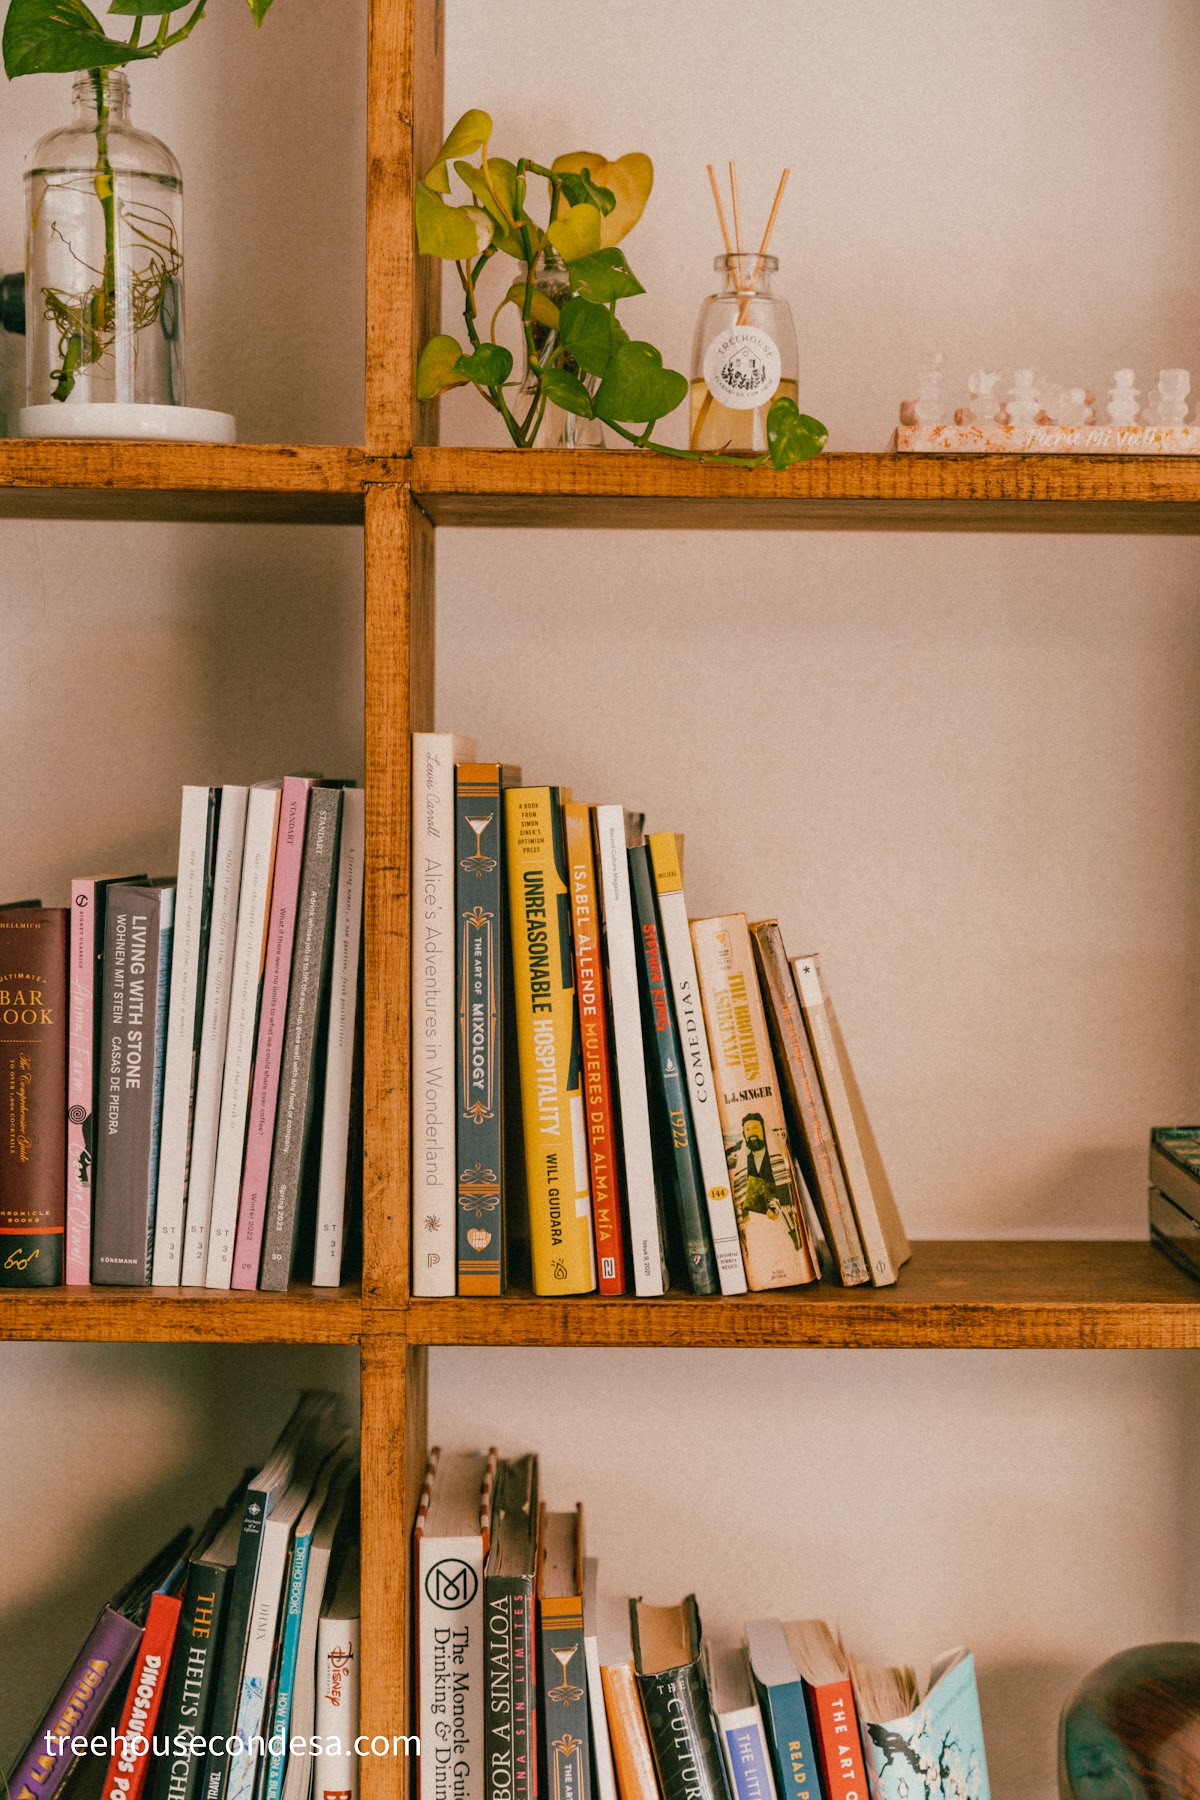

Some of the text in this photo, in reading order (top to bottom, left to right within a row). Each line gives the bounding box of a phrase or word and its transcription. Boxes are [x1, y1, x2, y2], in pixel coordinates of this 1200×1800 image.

[717, 334, 773, 357] TREEHOUSE
[426, 752, 440, 838] Lewis Carroll
[286, 800, 297, 845] STANDART
[315, 809, 326, 855] STANDART
[611, 872, 620, 901] Magazine
[278, 907, 286, 928] What
[308, 897, 317, 916] drink
[306, 917, 314, 942] whose
[572, 864, 596, 1015] ISABEL ALLENDE
[275, 935, 283, 955] there
[303, 941, 312, 954] job
[304, 954, 311, 962] is
[272, 975, 277, 985] no
[303, 962, 309, 971] to
[642, 924, 671, 1032] STEPHEN KING
[0, 990, 43, 1006] BAR
[125, 915, 146, 1088] LIVING WITH STONE
[270, 986, 278, 1007] limits
[300, 981, 308, 996] the
[0, 1008, 54, 1024] OOK
[269, 1007, 275, 1016] to
[298, 997, 306, 1013] soul
[472, 936, 484, 1089] THE ART OF MIXOLOGY
[522, 870, 560, 1136] UNREASONABLE HOSPITALITY
[72, 978, 93, 1091] Animal Farm
[108, 914, 126, 1135] WOHNEN MIT STEIN CASAS DE PIEDRA
[267, 1017, 275, 1035] what
[424, 857, 443, 1185] Alice's Adventures in Wonderland
[714, 987, 741, 1068] ASHKENAZI
[727, 971, 761, 1081] THE BROTHERS
[266, 1036, 271, 1047] we
[293, 1026, 301, 1044] goes
[680, 981, 708, 1103] COMEDIAS
[9, 1059, 14, 1069] TO
[263, 1048, 272, 1069] could
[293, 1044, 301, 1060] well
[261, 1070, 270, 1090] share
[291, 1060, 299, 1078] with
[288, 1078, 296, 1092] any
[739, 1086, 772, 1101] SINGER
[16, 1052, 31, 1162] The Comprehensive Guide
[288, 1092, 296, 1109] food
[256, 1108, 266, 1135] coffee?
[287, 1110, 292, 1119] or
[282, 1119, 291, 1154] company.
[584, 1022, 614, 1241] MUJERES DEL ALMA MÍA
[669, 1108, 689, 1149] 1922
[68, 1141, 91, 1268] George Orwell
[277, 1184, 286, 1209] Spring
[545, 1153, 562, 1246] WILL GUIDARA
[711, 1189, 725, 1198] 144
[246, 1192, 257, 1241] Winter 2022
[472, 1231, 486, 1239] LOVE
[288, 1546, 305, 1615] ORTHO BOOKS
[190, 1590, 215, 1640] THE
[452, 1626, 468, 1664] The
[489, 1595, 510, 1712] SINALOA
[180, 1646, 207, 1717] HELL'S
[325, 1641, 353, 1706] Disney
[429, 1626, 451, 1714] Drinking
[513, 1595, 526, 1800] INA SIN LIMITES
[657, 1680, 685, 1694] THE
[276, 1691, 288, 1717] HOW
[452, 1671, 469, 1753] Monocle
[830, 1697, 848, 1734] THE
[275, 1719, 285, 1733] TO
[434, 1721, 451, 1741] &
[491, 1722, 509, 1741] A
[736, 1732, 754, 1763] THE
[28, 1752, 57, 1783] LA
[269, 1770, 279, 1778] &
[563, 1763, 572, 1782] THE
[787, 1740, 807, 1784] READ
[837, 1743, 854, 1780] ART
[206, 1770, 221, 1800] TRAVEL
